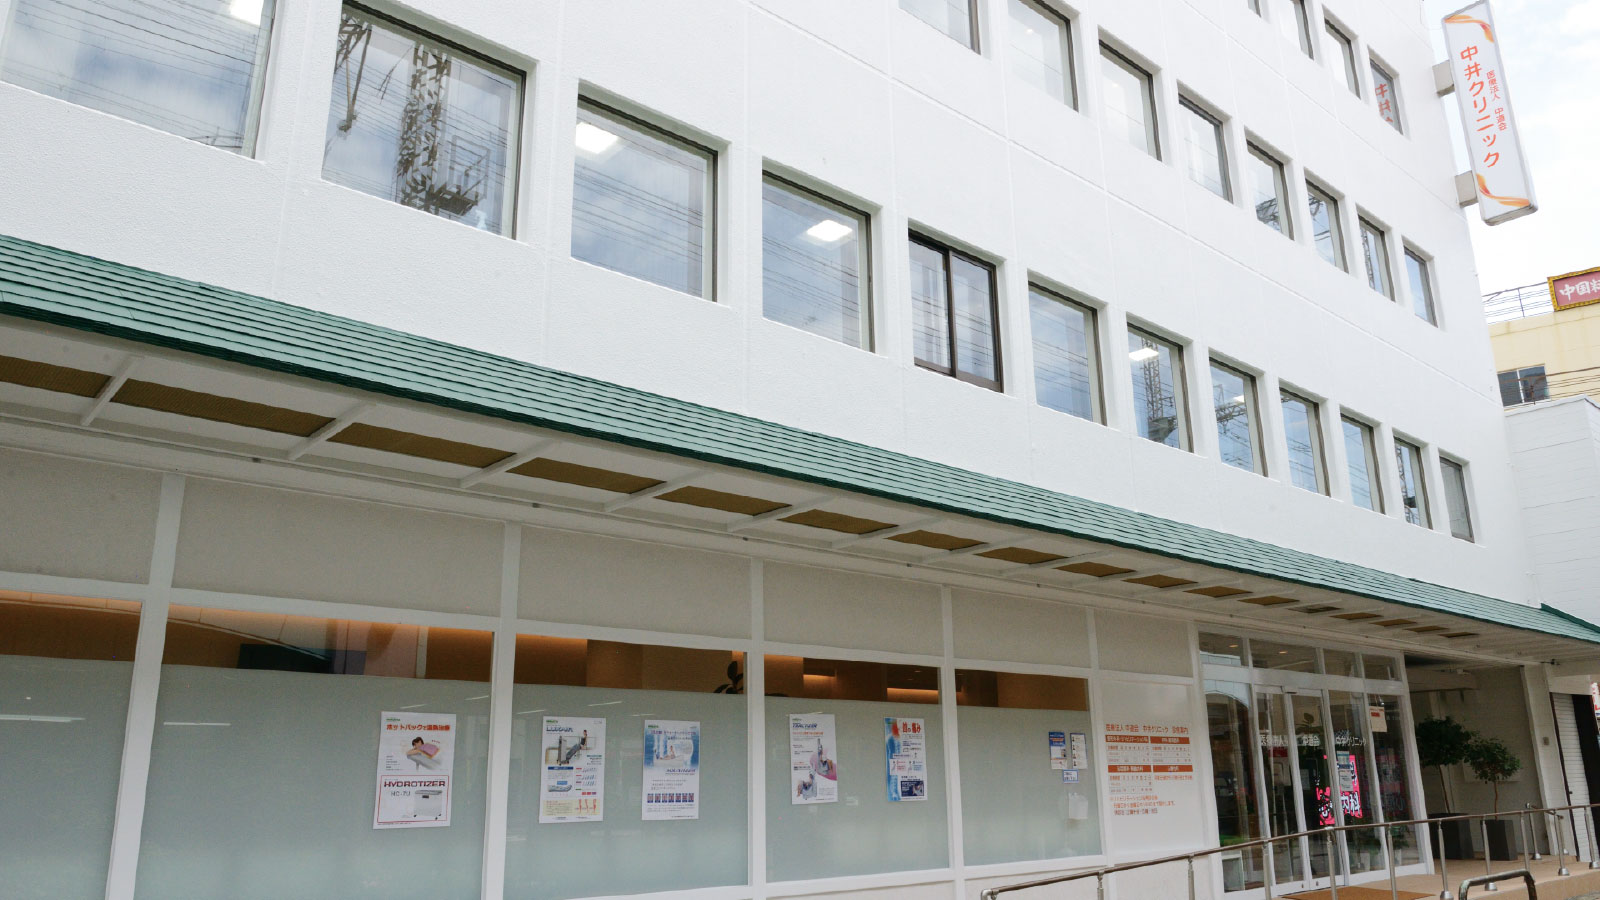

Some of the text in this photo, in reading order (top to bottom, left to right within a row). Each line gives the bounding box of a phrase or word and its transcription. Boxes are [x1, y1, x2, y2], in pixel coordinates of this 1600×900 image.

[1486, 69, 1501, 101] 医療法人
[1460, 45, 1500, 168] 中井クリニック
[383, 780, 446, 788] HYDROTIZER
